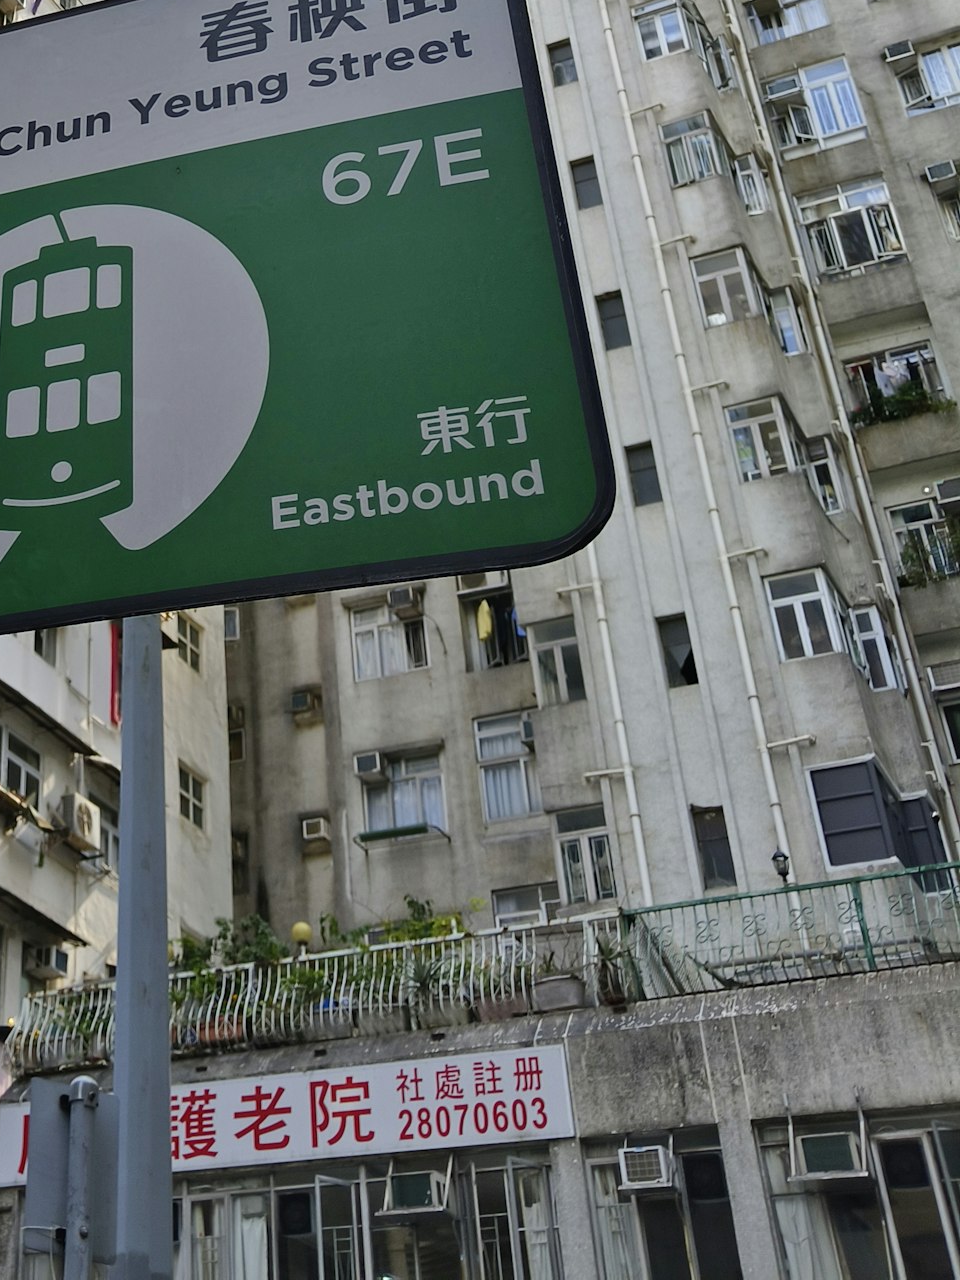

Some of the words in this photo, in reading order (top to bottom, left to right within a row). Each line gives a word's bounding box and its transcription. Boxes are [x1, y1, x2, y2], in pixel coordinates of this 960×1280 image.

[127, 70, 289, 126] Yeung
[307, 29, 473, 88] Street
[322, 128, 490, 205] 67E
[416, 395, 532, 456] 東行
[271, 459, 546, 530] Eastbound
[398, 1097, 548, 1141] 28070603
